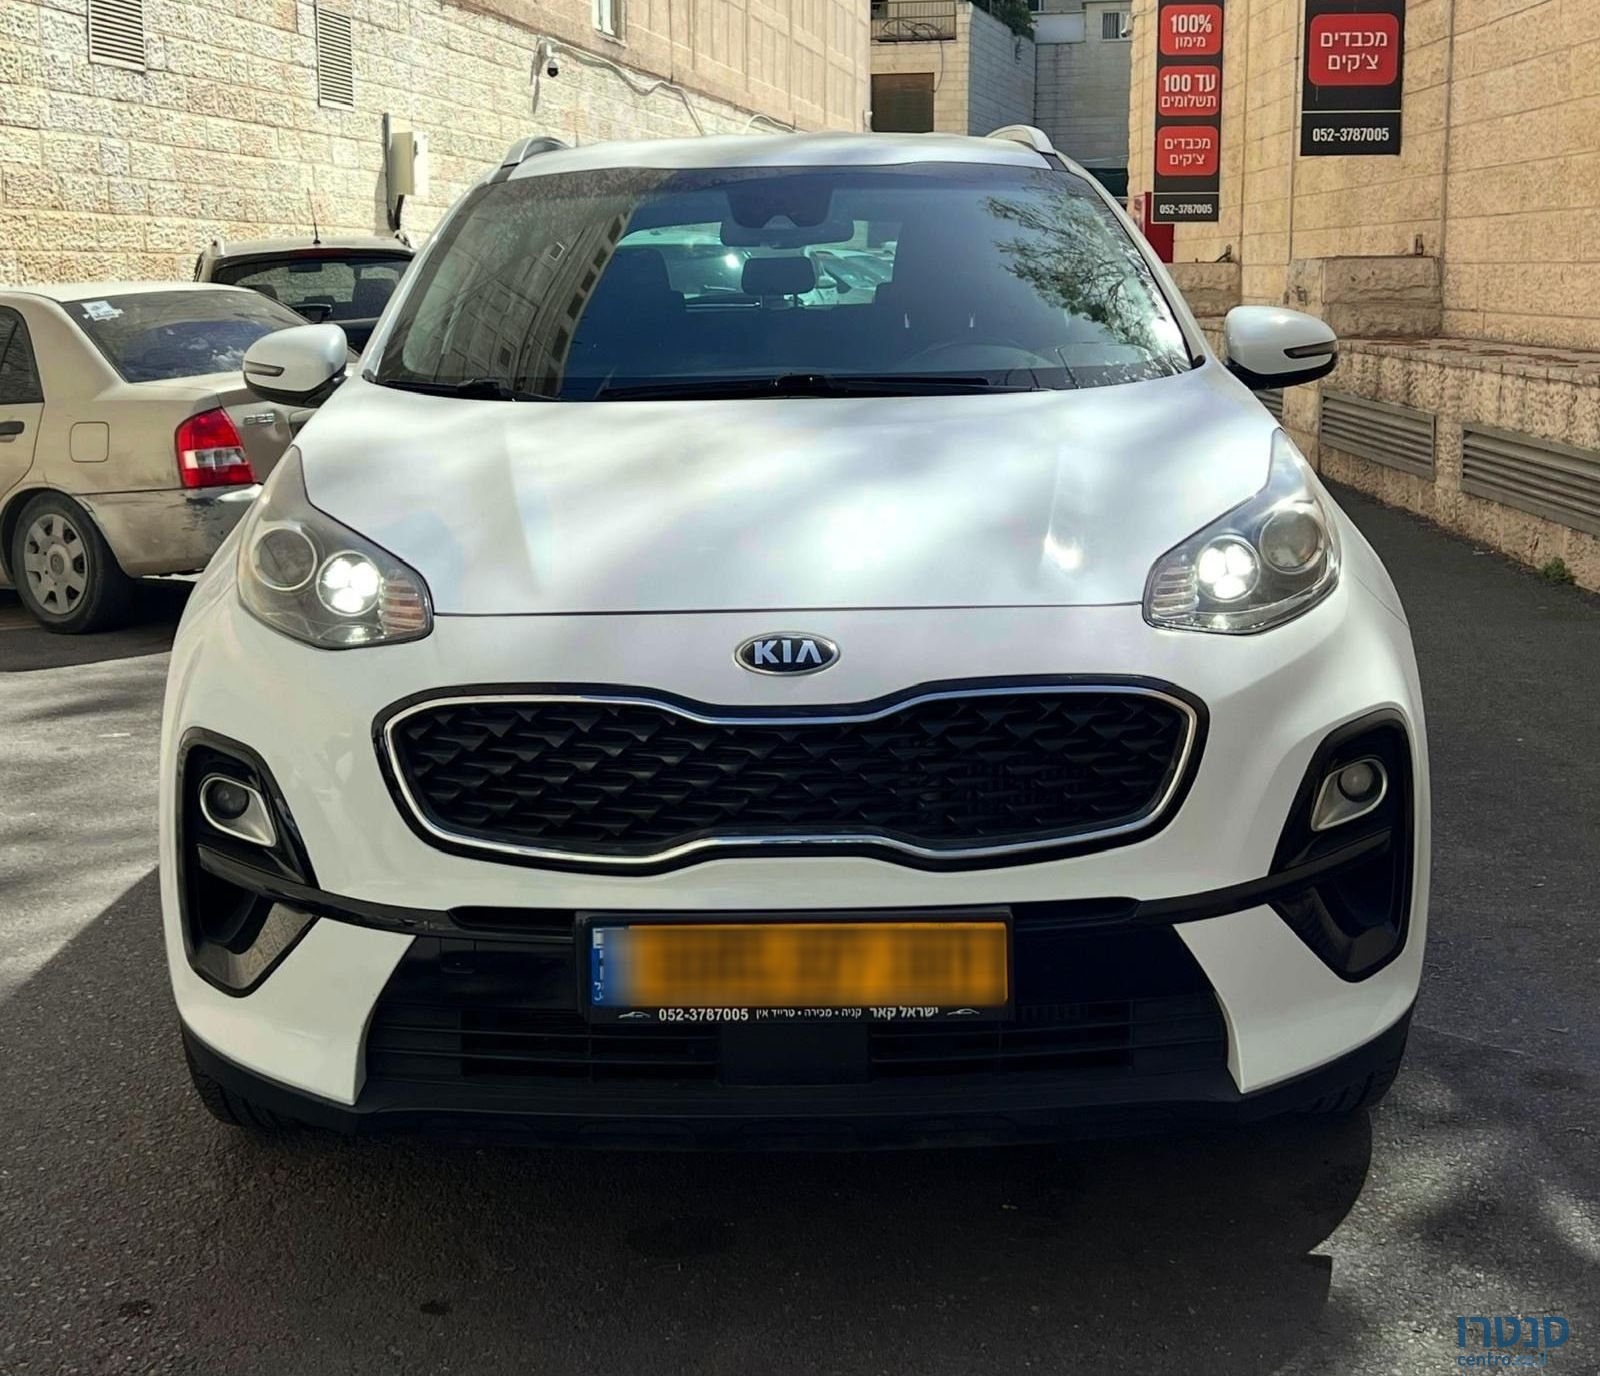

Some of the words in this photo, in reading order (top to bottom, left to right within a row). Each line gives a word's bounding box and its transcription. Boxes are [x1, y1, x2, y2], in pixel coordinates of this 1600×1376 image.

[1171, 14, 1212, 33] 100%
[1175, 36, 1206, 49] מימון
[1320, 31, 1388, 48] מכבדים
[1163, 74, 1191, 93] 100
[1194, 74, 1216, 93] עד
[1161, 94, 1216, 108] תשלומים
[1312, 127, 1390, 142] 052-3787005
[1164, 138, 1211, 150] מכבדים
[1159, 204, 1213, 215] 052-3787005
[753, 639, 823, 665] KIA
[658, 1008, 749, 1021] 052-3787005
[771, 1008, 796, 1018] טרייד
[804, 1008, 832, 1018] מכירה
[841, 1008, 862, 1019] קניה
[869, 1006, 897, 1020] קאר
[899, 1005, 939, 1018] ישראל
